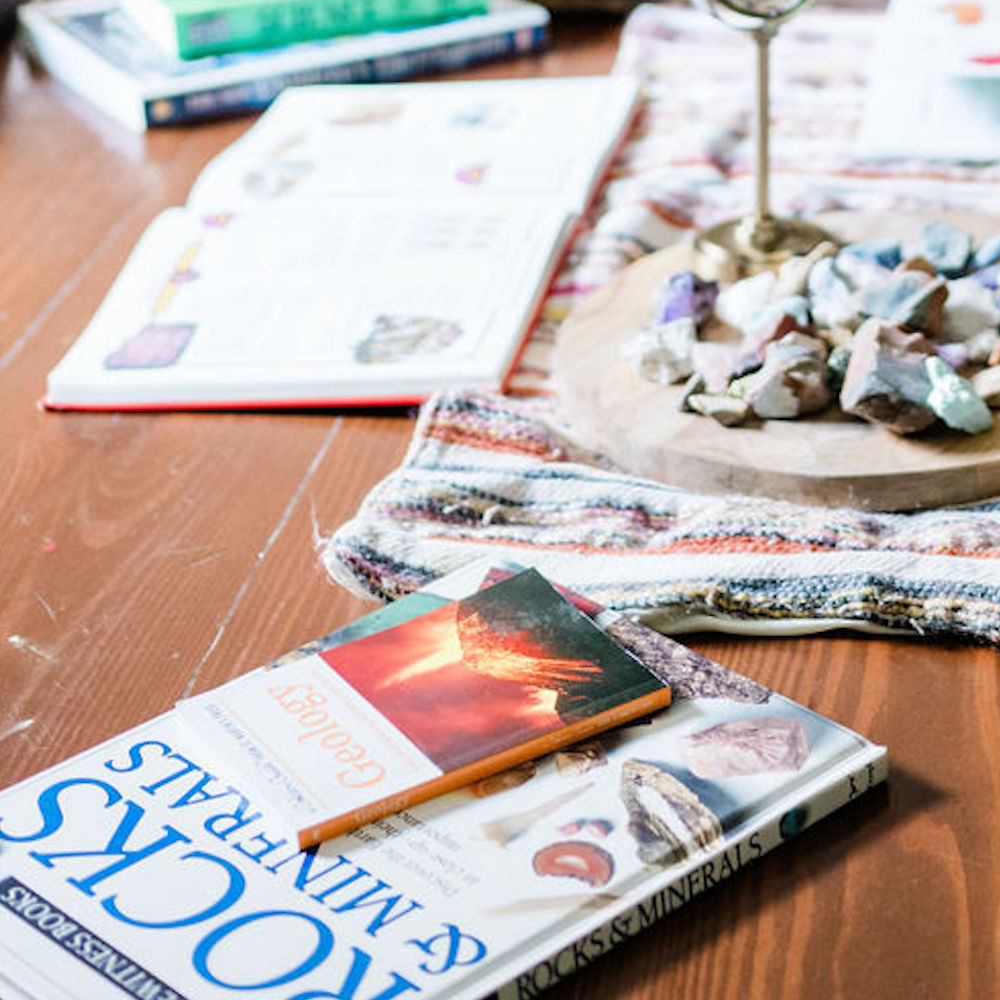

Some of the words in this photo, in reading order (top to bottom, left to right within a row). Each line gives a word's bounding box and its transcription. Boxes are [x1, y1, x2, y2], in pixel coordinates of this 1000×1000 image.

[266, 682, 387, 789] Geology
[104, 740, 424, 937] MINERALS
[2, 885, 79, 941] BOOKS
[404, 922, 487, 975] &
[515, 926, 605, 1000] ROCKS
[608, 915, 633, 942] &
[636, 831, 764, 928] MINERALS
